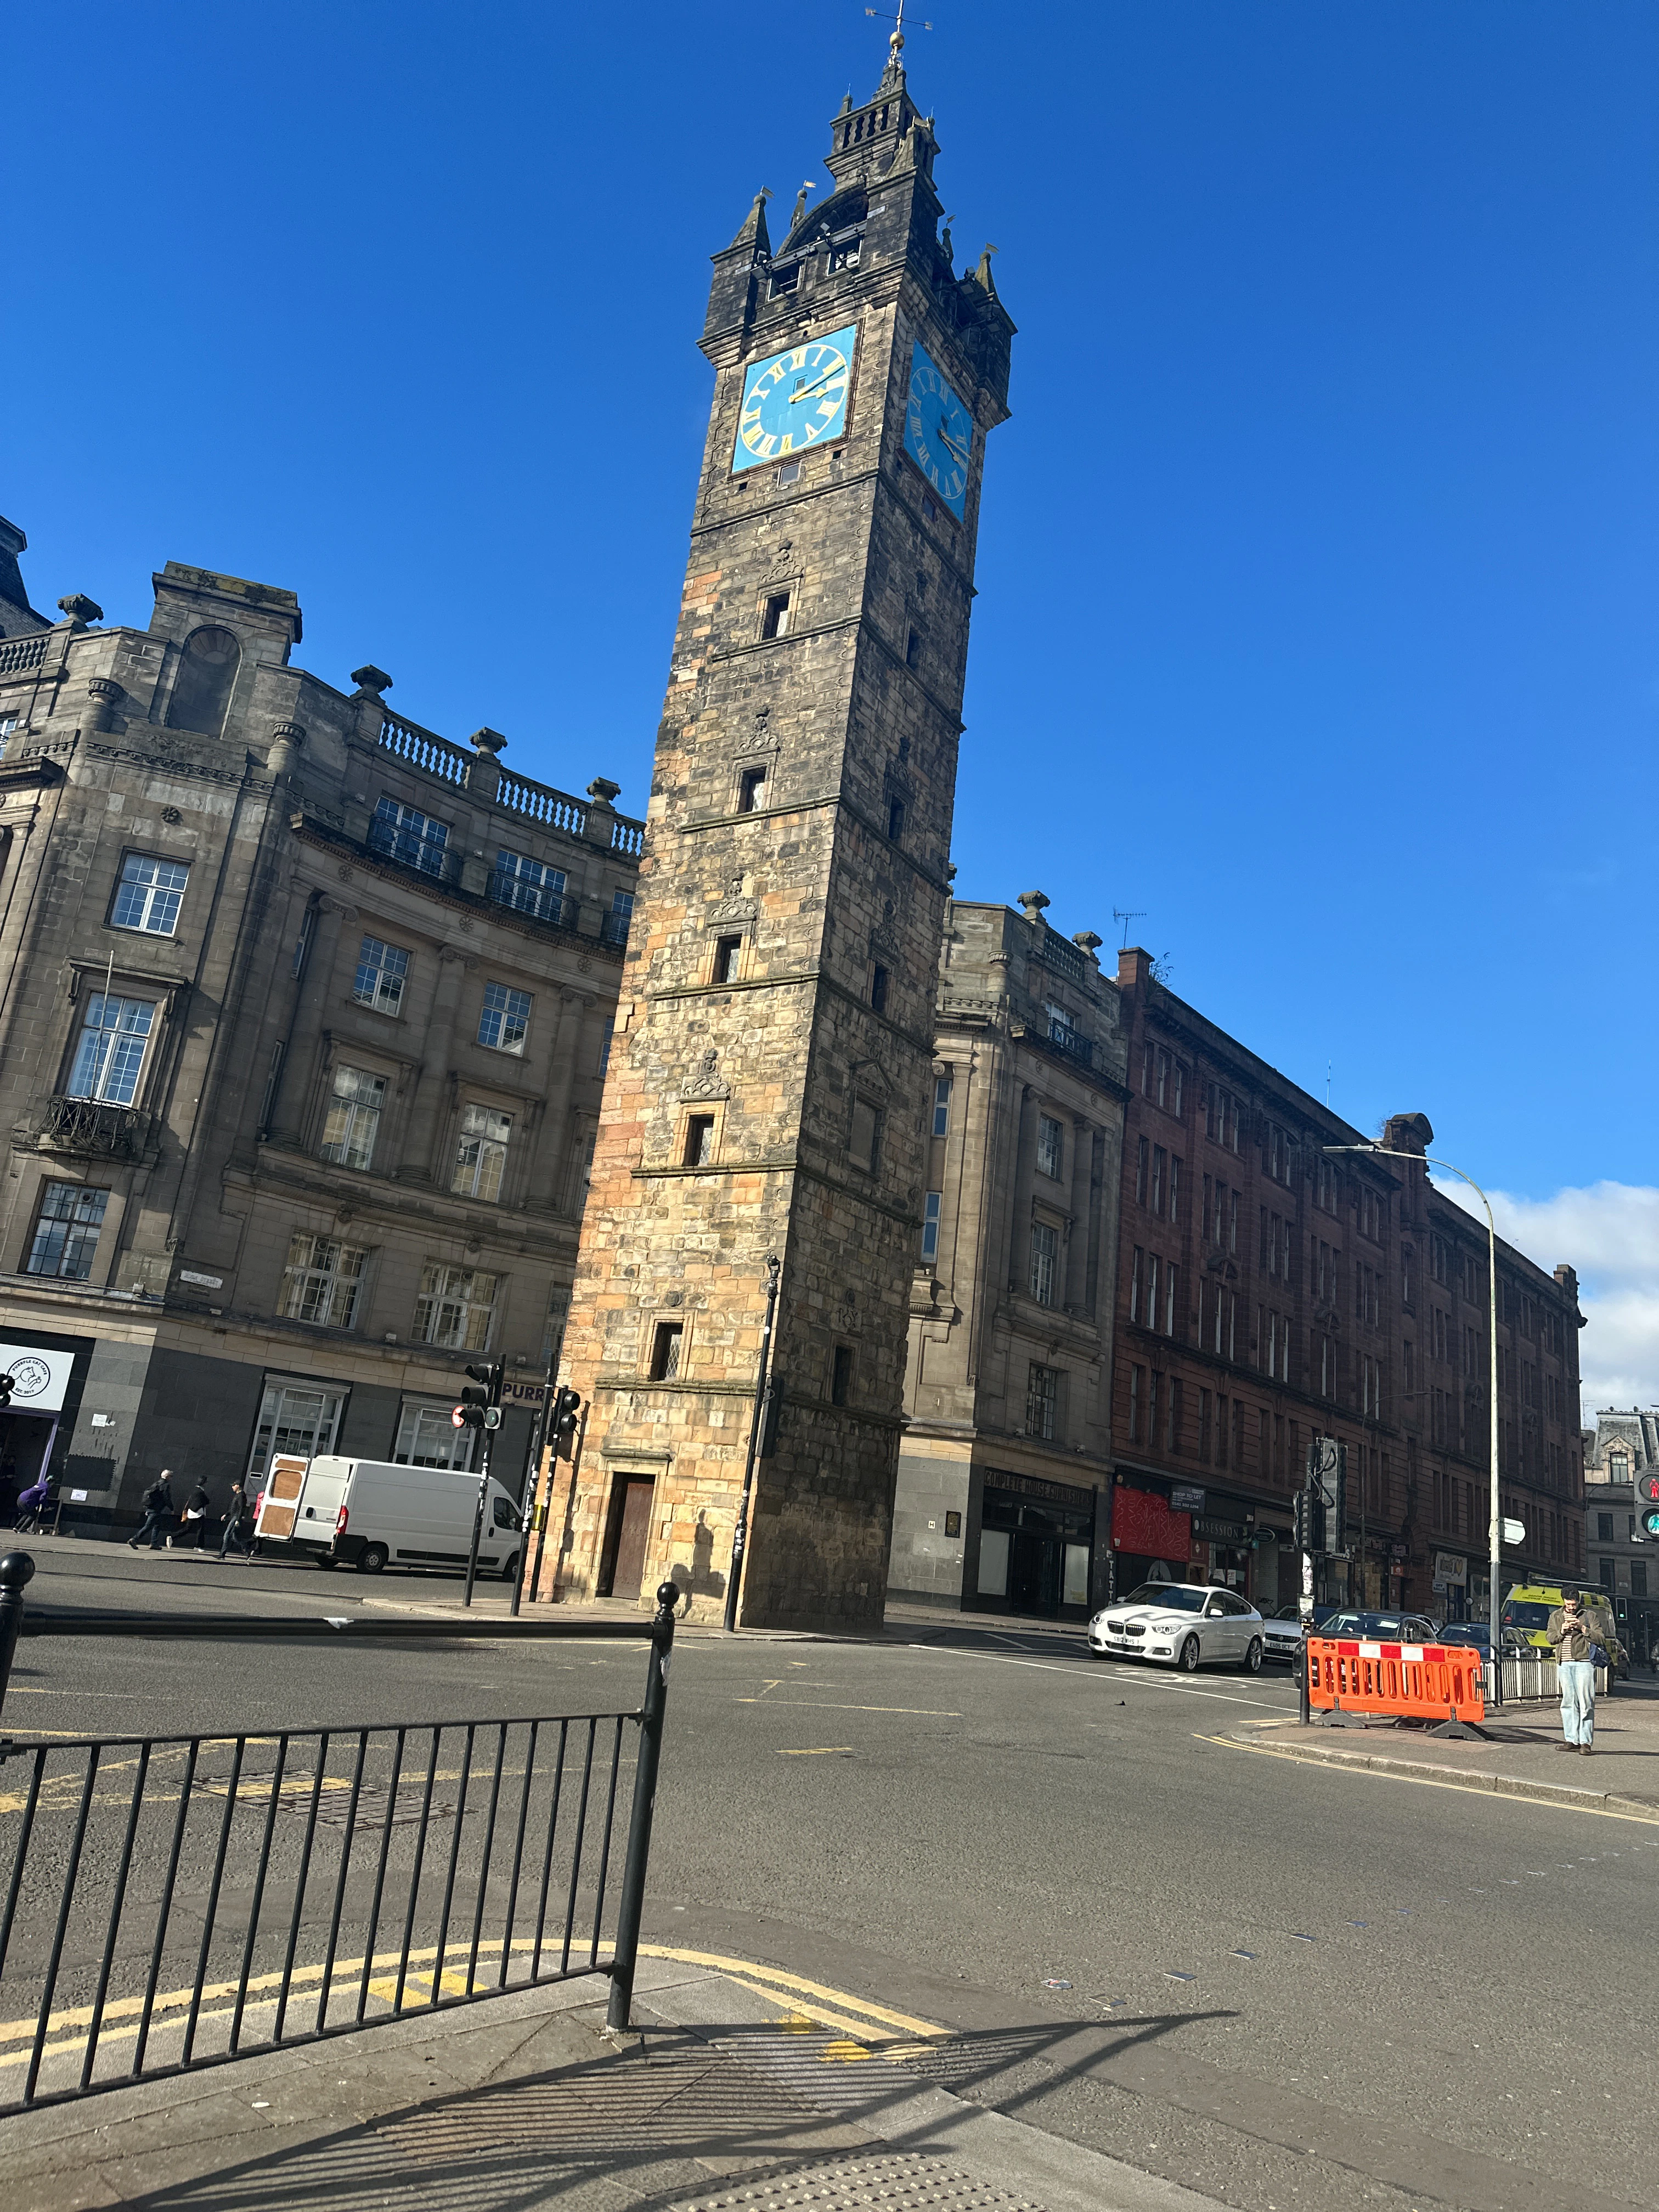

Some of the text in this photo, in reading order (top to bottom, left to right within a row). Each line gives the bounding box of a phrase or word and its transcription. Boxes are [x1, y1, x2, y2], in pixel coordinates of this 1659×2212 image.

[789, 348, 808, 371] XII
[768, 362, 787, 384] XI
[751, 386, 770, 400] X
[742, 406, 762, 425] IX
[805, 422, 819, 439] V
[985, 1471, 1023, 1492] COMPLETE
[1025, 1479, 1048, 1497] HOUSE
